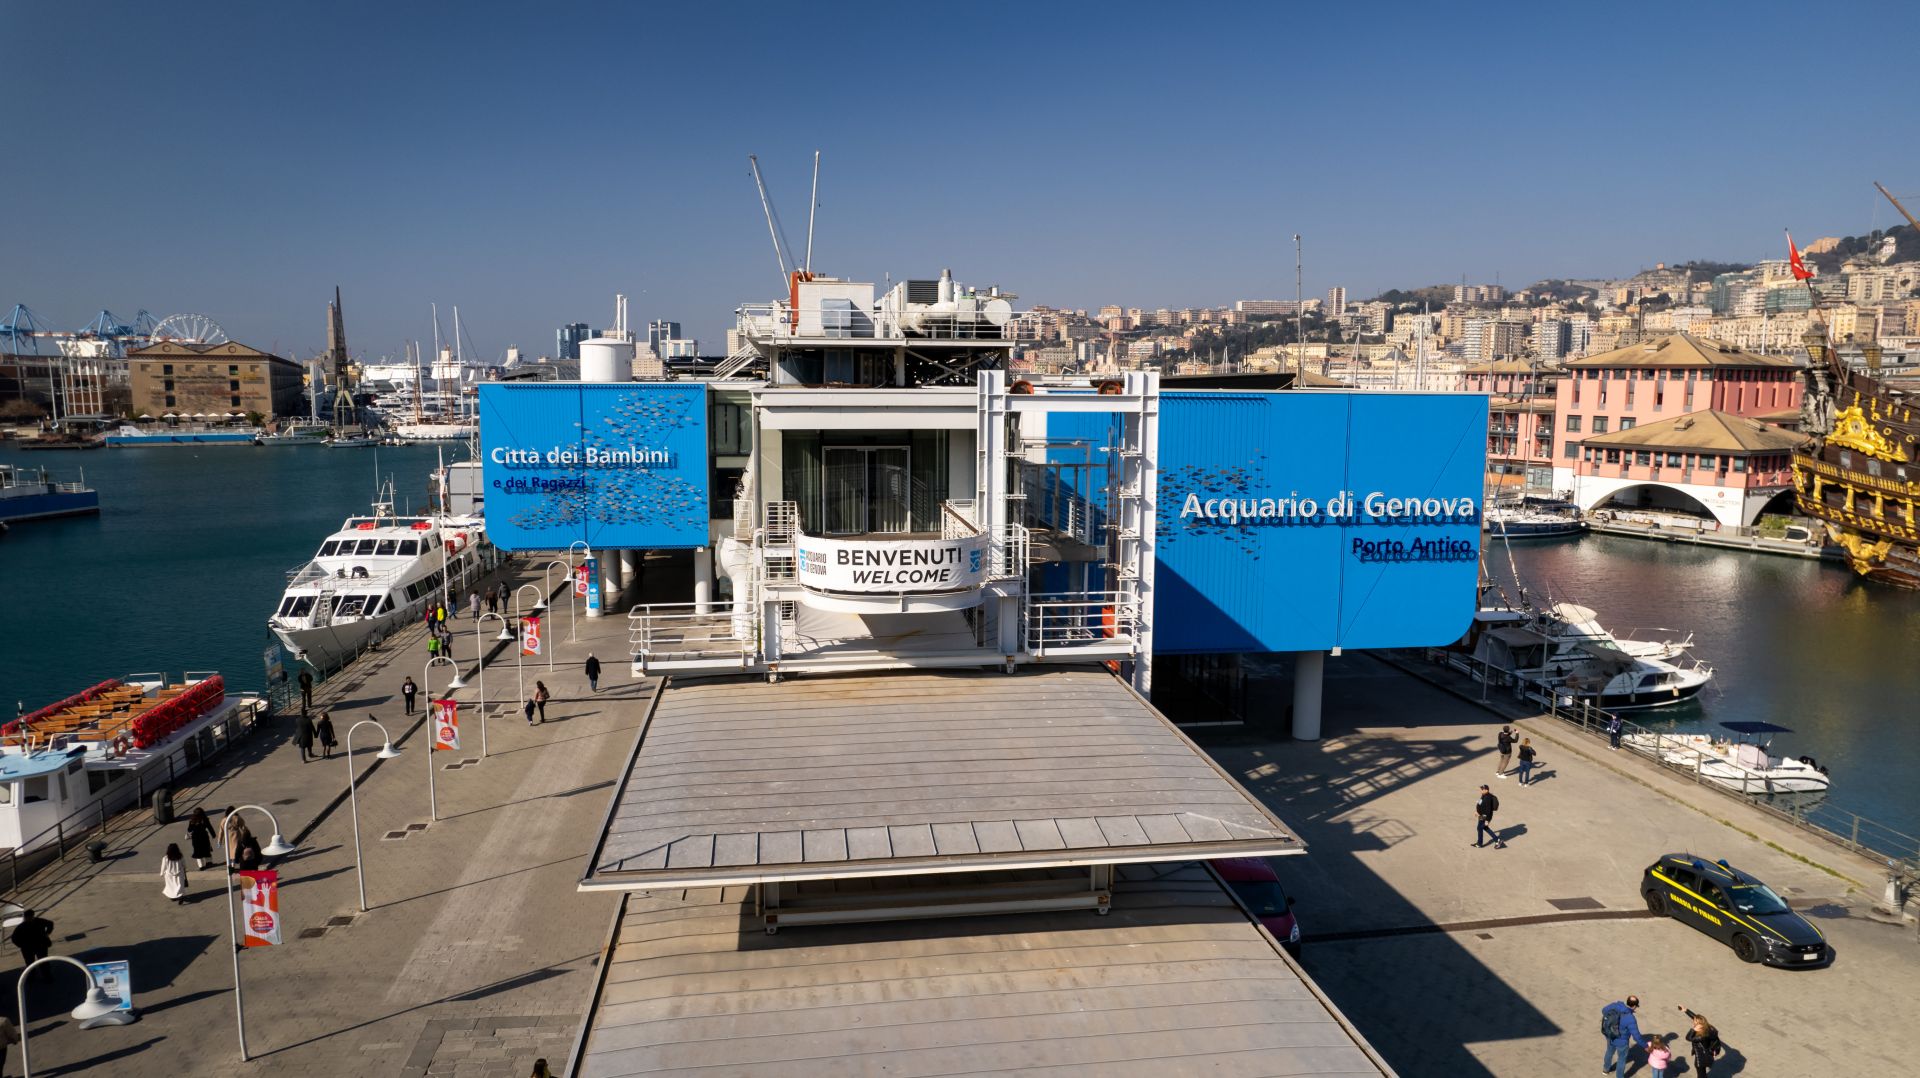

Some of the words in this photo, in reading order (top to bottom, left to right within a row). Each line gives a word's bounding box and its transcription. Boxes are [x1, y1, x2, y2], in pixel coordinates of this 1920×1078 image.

[491, 446, 540, 464] Città
[547, 446, 578, 464] dei
[586, 446, 669, 464] Bambini
[493, 479, 502, 488] e
[506, 476, 527, 488] dei
[532, 476, 585, 492] Ragazzi
[1180, 490, 1318, 525] Acquario
[1326, 490, 1354, 518] di
[1364, 491, 1474, 518] Genova
[1352, 537, 1404, 554] Porto
[1410, 536, 1471, 554] Antico
[837, 547, 962, 566] BENVENUTI
[853, 568, 951, 584] WELCOME
